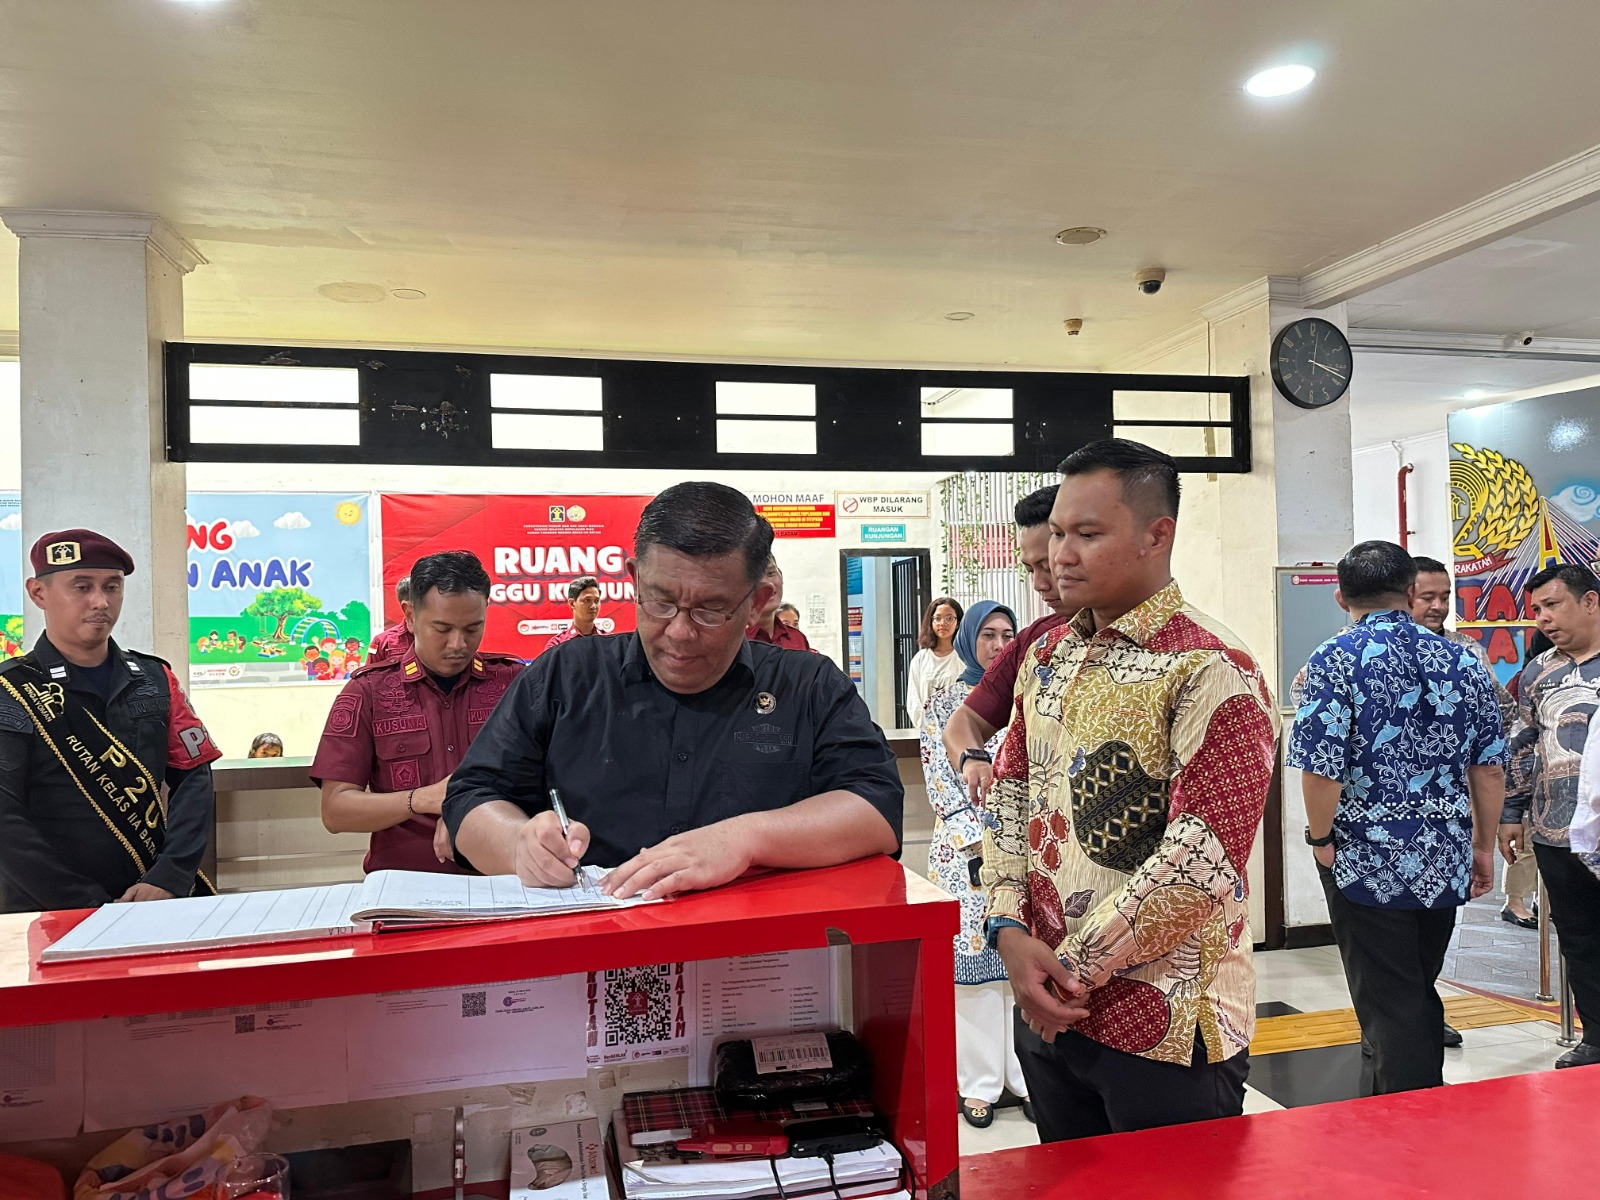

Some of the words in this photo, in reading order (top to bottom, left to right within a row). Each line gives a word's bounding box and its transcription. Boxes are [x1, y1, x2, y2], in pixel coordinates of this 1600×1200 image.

[753, 494, 793, 503] MOHON
[795, 494, 824, 503] MAAF
[860, 496, 878, 504] WBP
[881, 496, 923, 504] DILARANG
[873, 505, 903, 513] MASUK
[211, 559, 312, 588] ANAK
[494, 545, 623, 575] RUANG
[66, 735, 101, 774] RUTAN
[96, 773, 131, 812] KELAS
[127, 812, 142, 831] IIA
[139, 828, 158, 860] BATA
[675, 962, 686, 1038] BATAM
